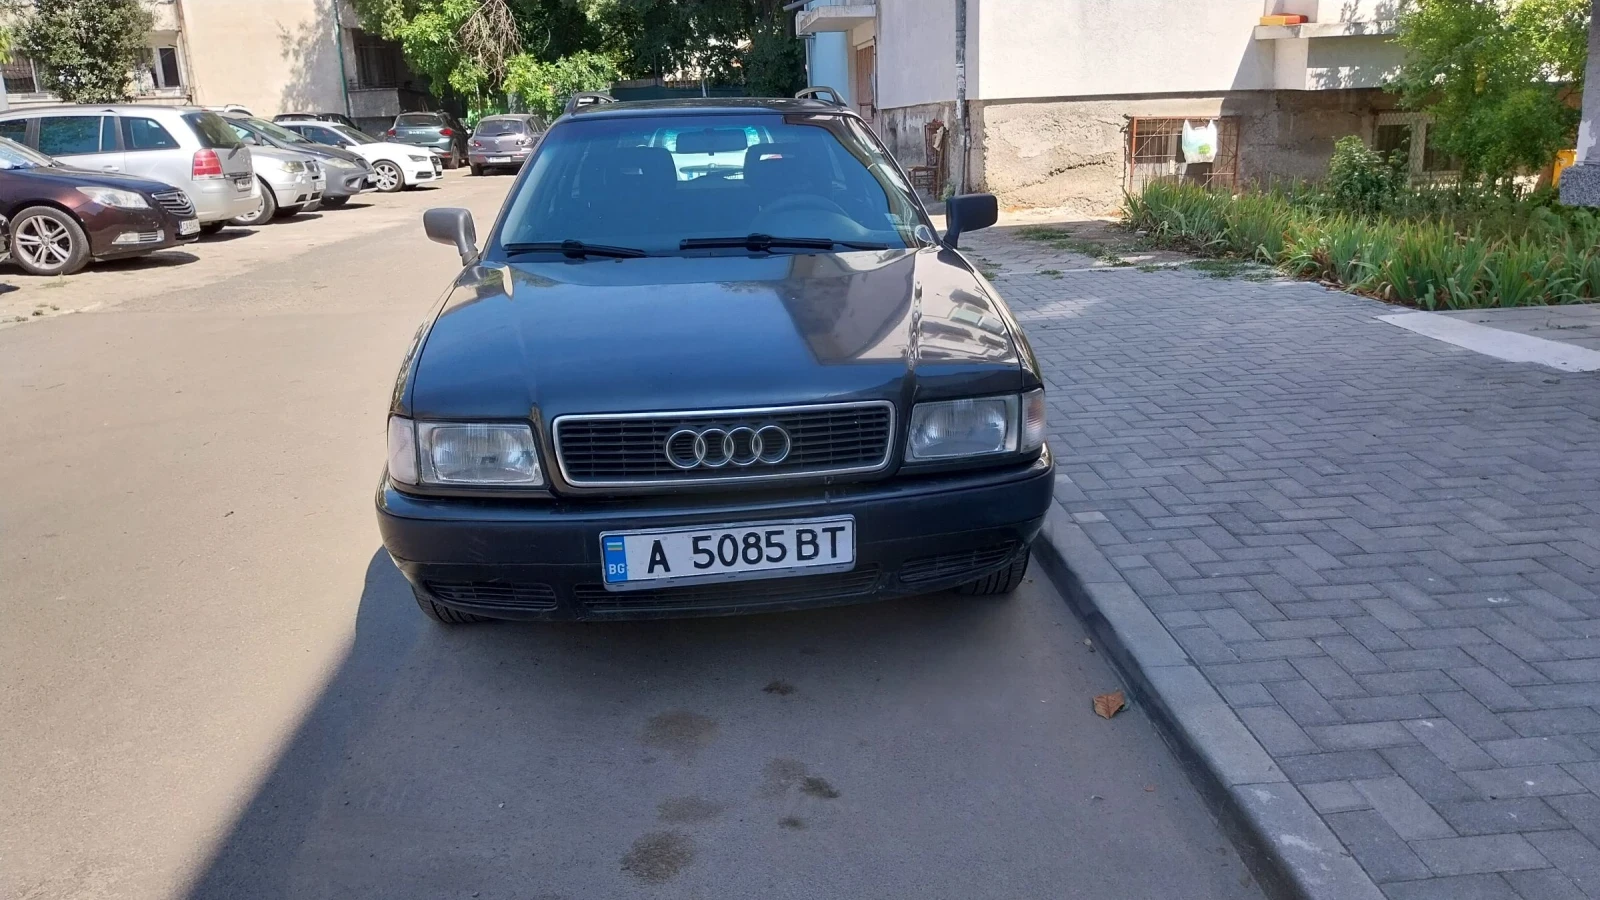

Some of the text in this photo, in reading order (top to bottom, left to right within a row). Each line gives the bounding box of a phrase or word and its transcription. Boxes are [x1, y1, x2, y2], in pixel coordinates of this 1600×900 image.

[648, 527, 846, 574] A 5085 BT
[609, 563, 625, 576] BG
